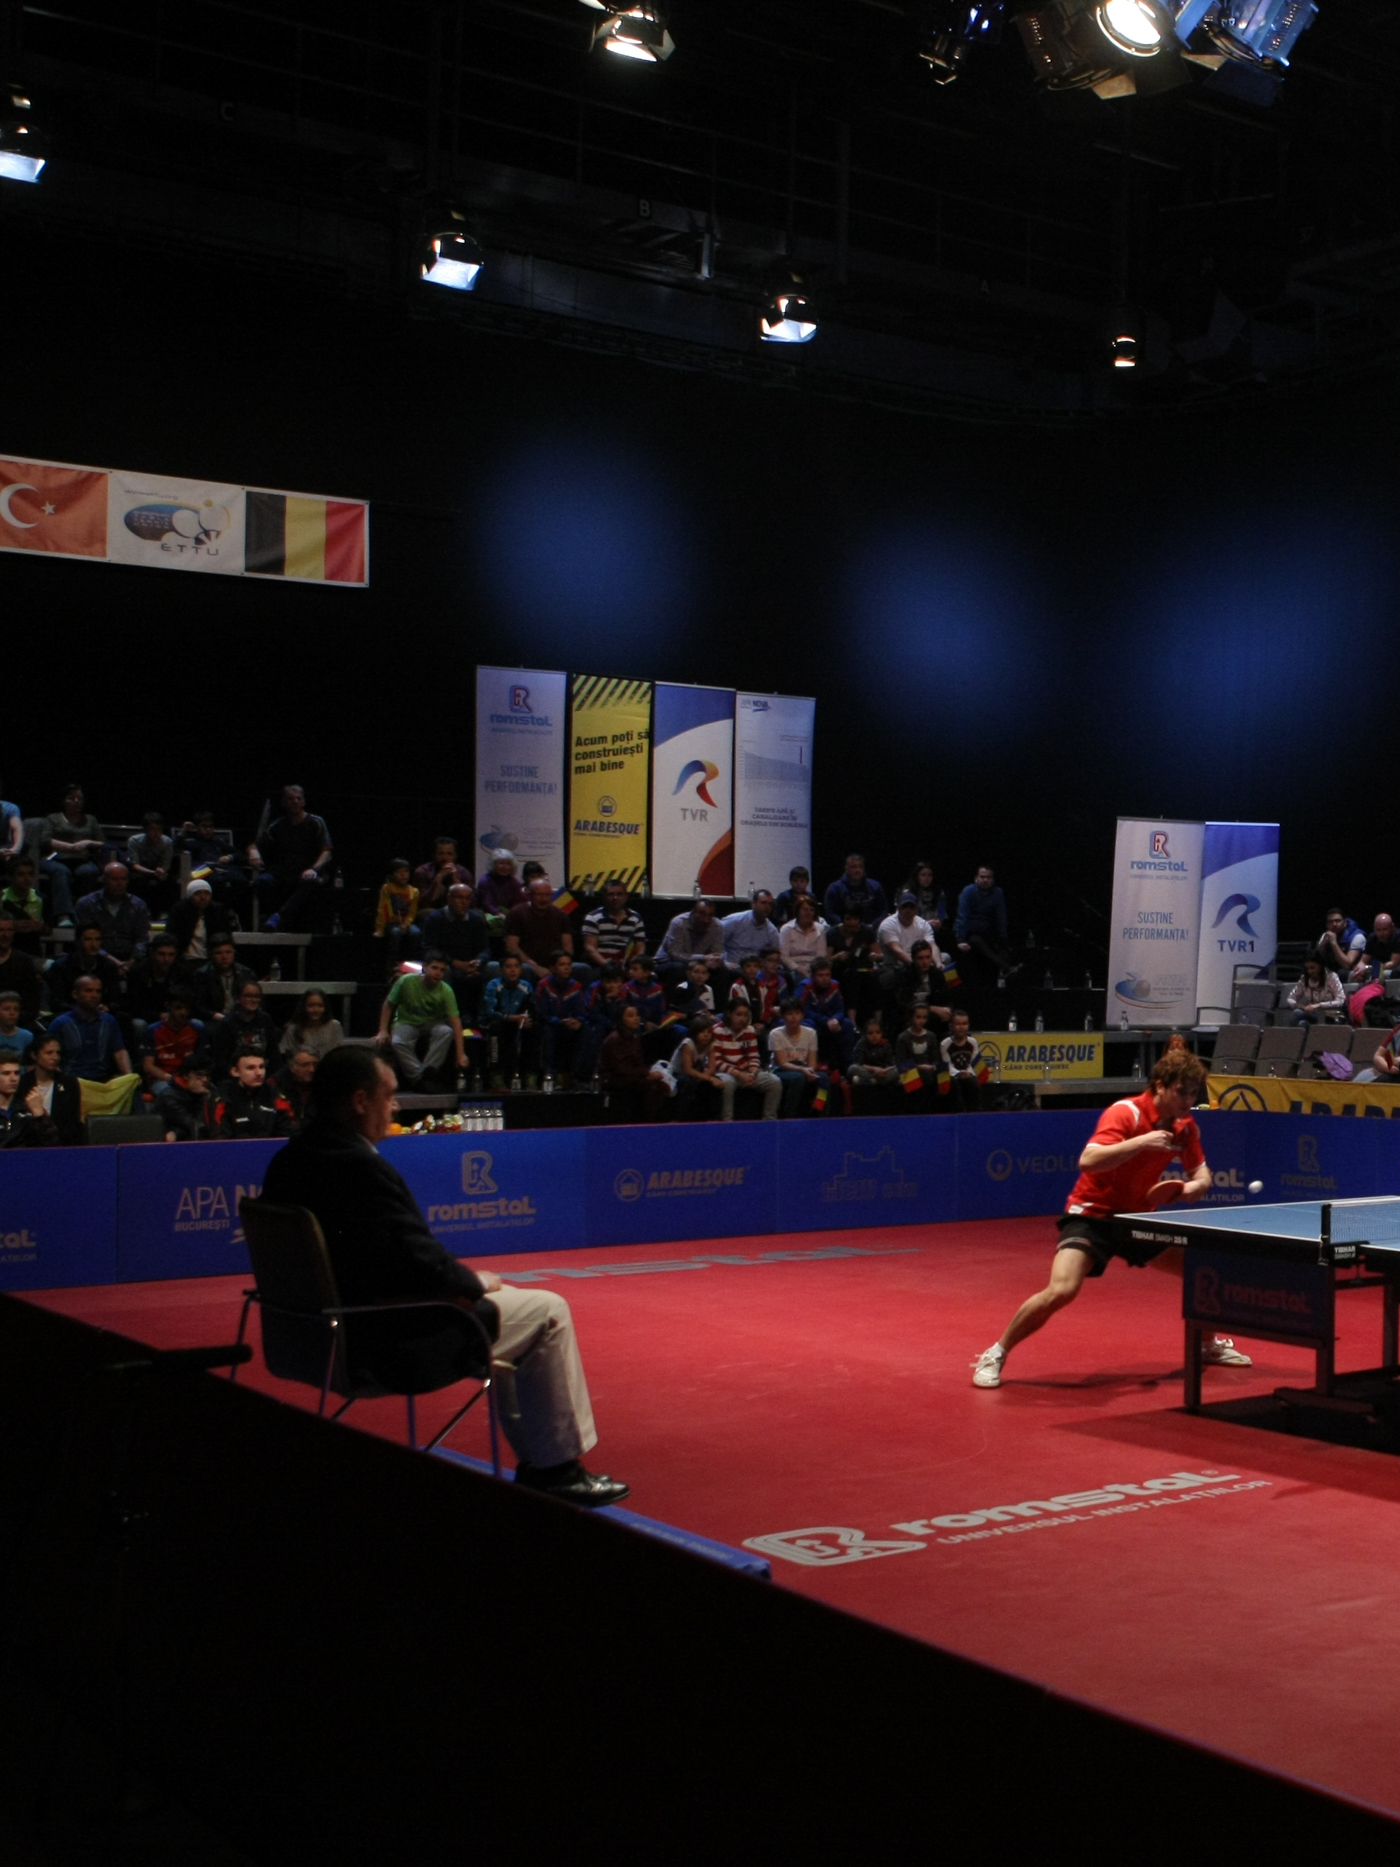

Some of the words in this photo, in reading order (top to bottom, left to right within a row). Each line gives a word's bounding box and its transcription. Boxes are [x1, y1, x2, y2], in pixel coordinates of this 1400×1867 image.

[161, 543, 219, 556] ETTU
[575, 736, 608, 748] Acum
[575, 762, 596, 775] mai
[600, 760, 625, 772] bine
[680, 807, 709, 822] TVR
[574, 819, 640, 835] ARABESQUE
[1217, 939, 1255, 952] TVR1
[1005, 1044, 1096, 1063] ARABESQUE
[1017, 1154, 1080, 1173] VEOLI
[647, 1166, 746, 1189] ARABESQUE
[175, 1185, 230, 1220] APA
